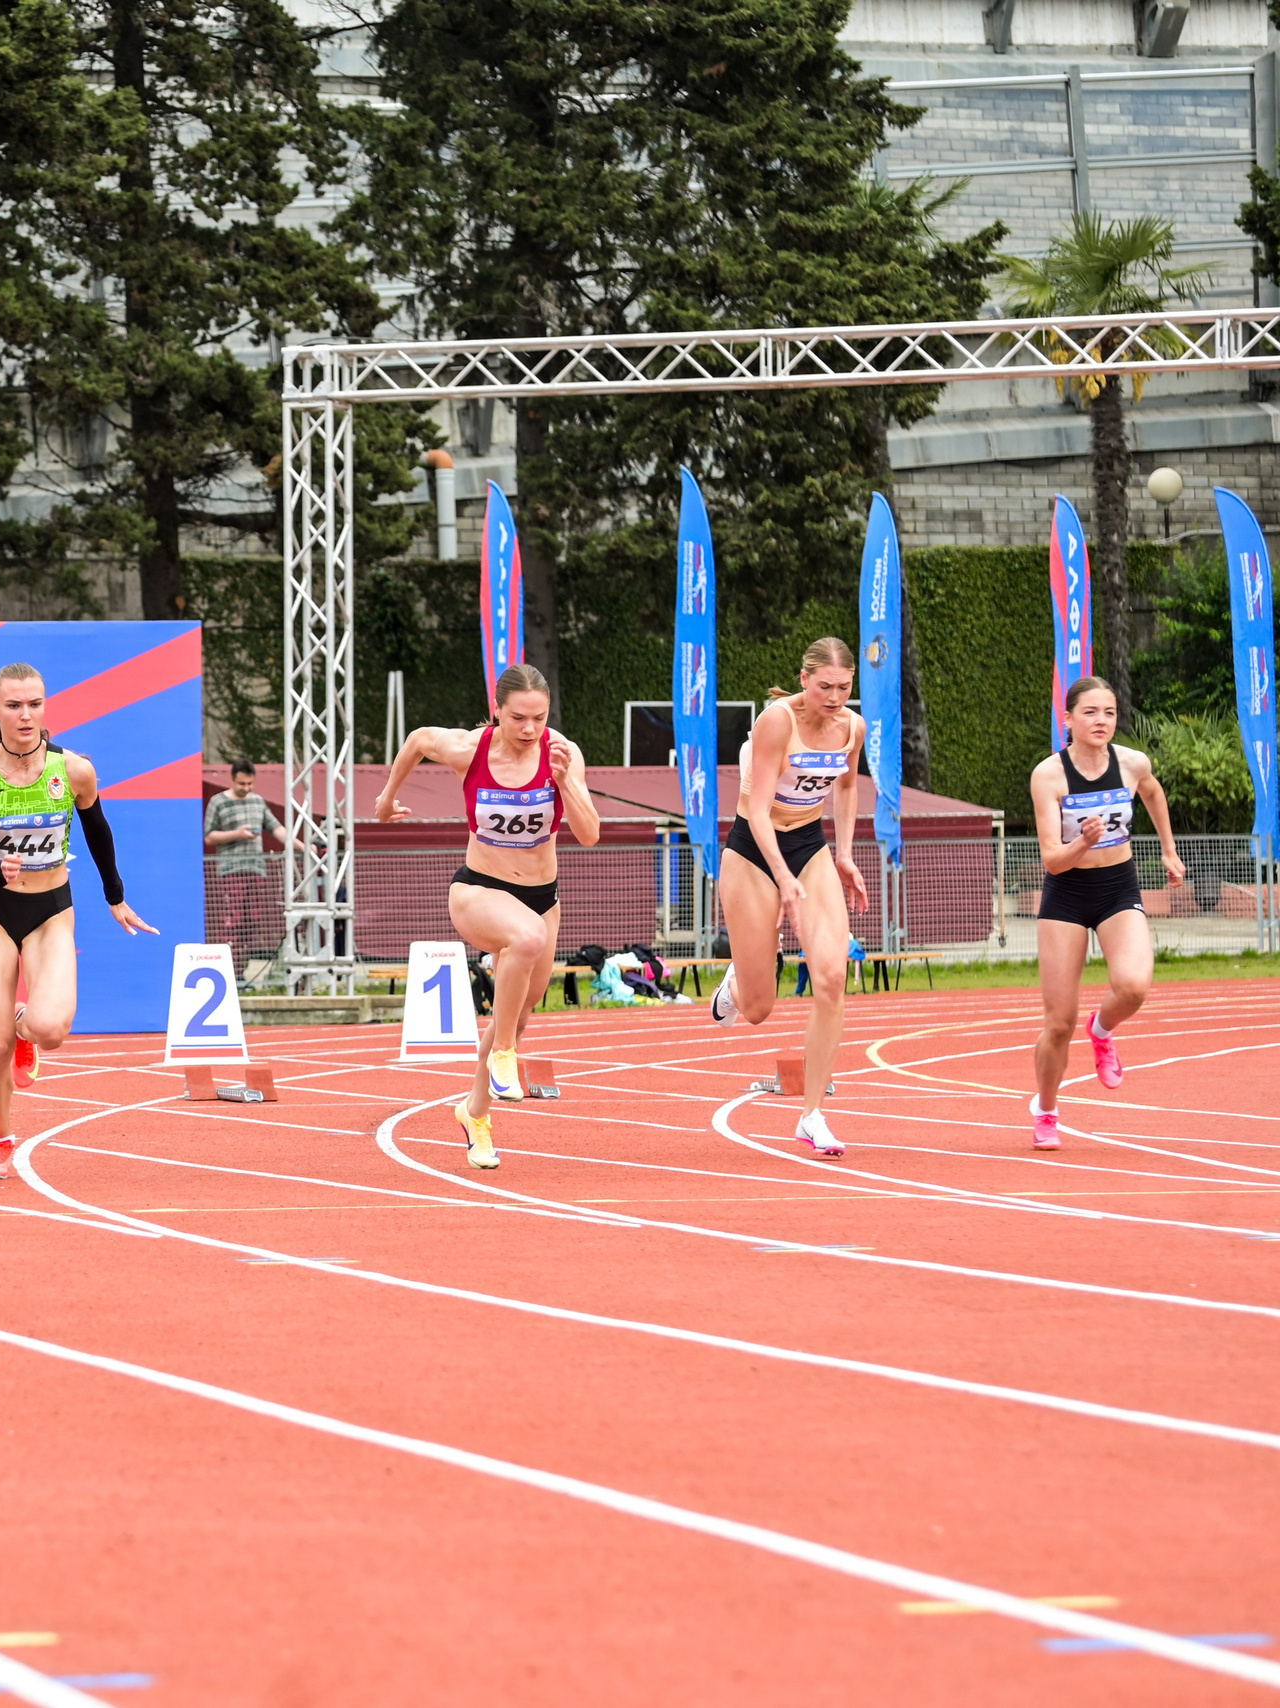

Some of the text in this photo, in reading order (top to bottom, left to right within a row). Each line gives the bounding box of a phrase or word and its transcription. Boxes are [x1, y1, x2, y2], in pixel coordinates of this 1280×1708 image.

[490, 792, 516, 800] azimut
[3, 817, 28, 826] azimut
[488, 812, 544, 835] 265
[184, 967, 228, 1037] 2
[422, 964, 454, 1034] 1
